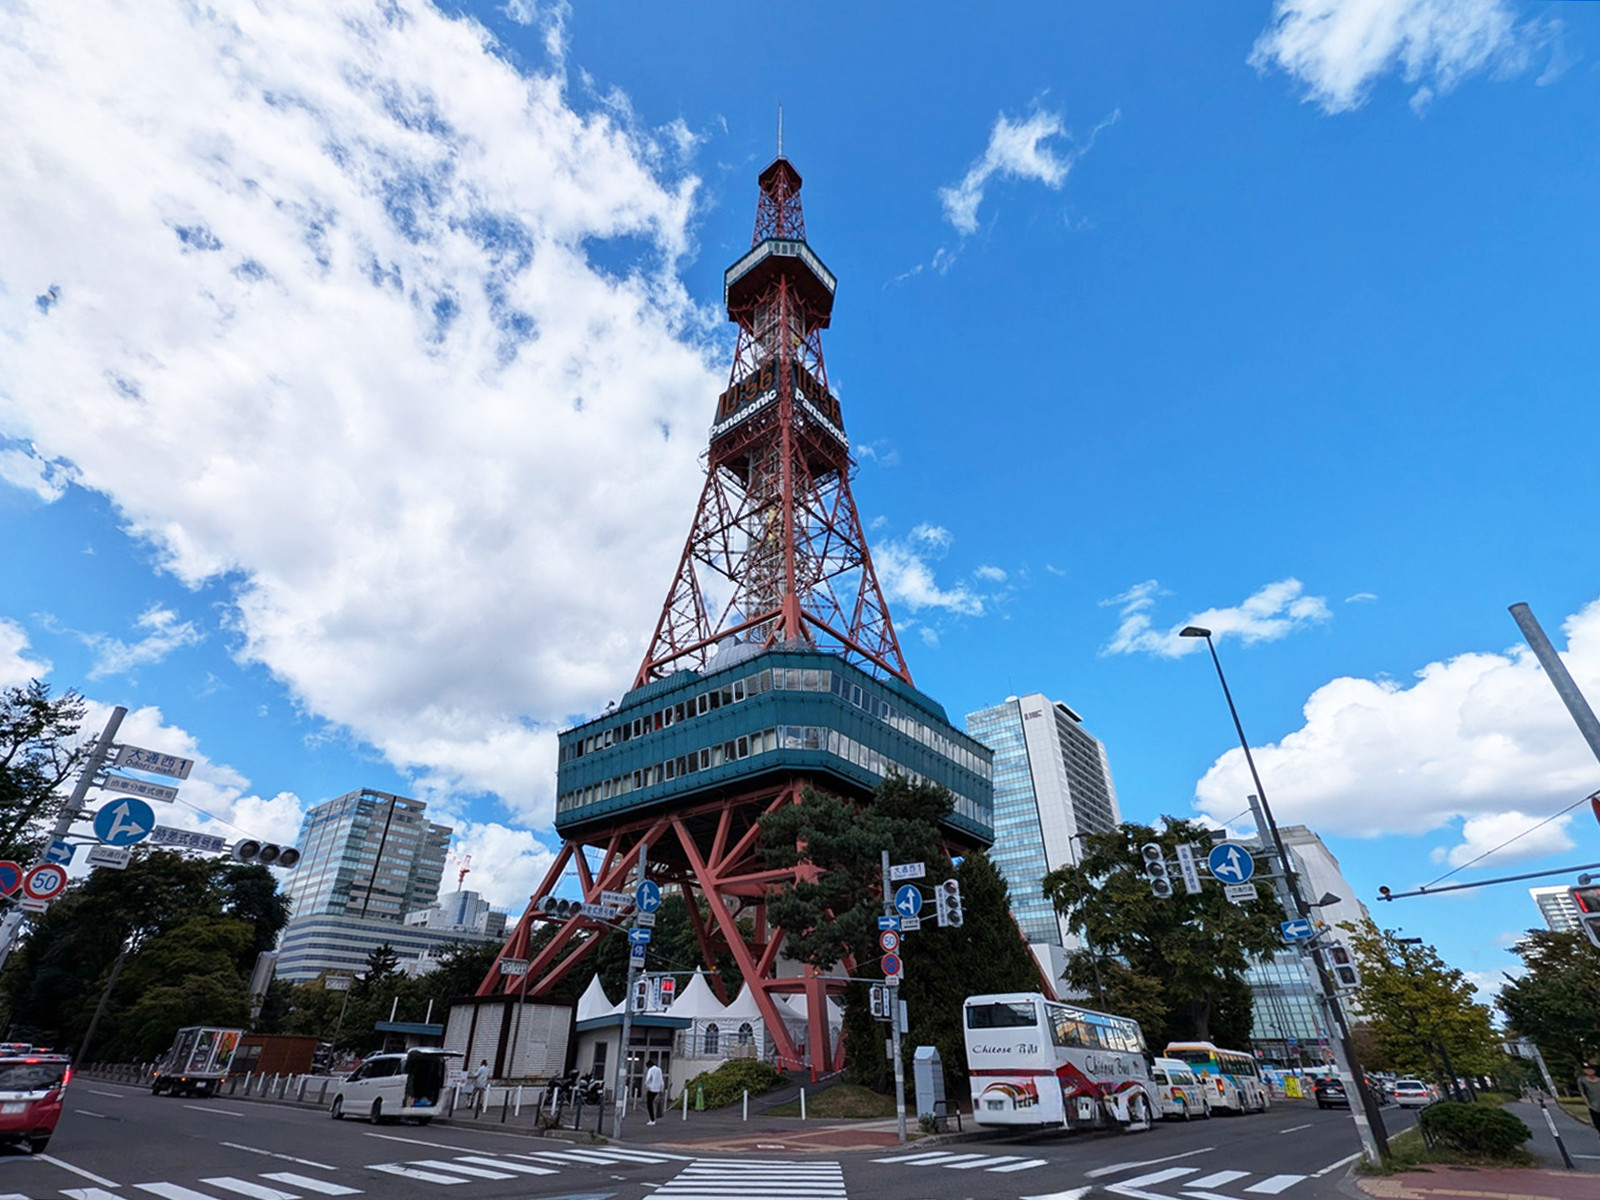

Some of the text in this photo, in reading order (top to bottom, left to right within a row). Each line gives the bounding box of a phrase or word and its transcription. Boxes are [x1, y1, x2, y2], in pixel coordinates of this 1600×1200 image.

[718, 361, 773, 418] 10:56
[708, 389, 778, 439] Panasonic
[794, 388, 851, 447] Panasonic
[127, 748, 188, 771] 大通西1
[32, 871, 58, 891] 50
[884, 935, 895, 947] 50
[972, 1045, 1012, 1054] Chitose
